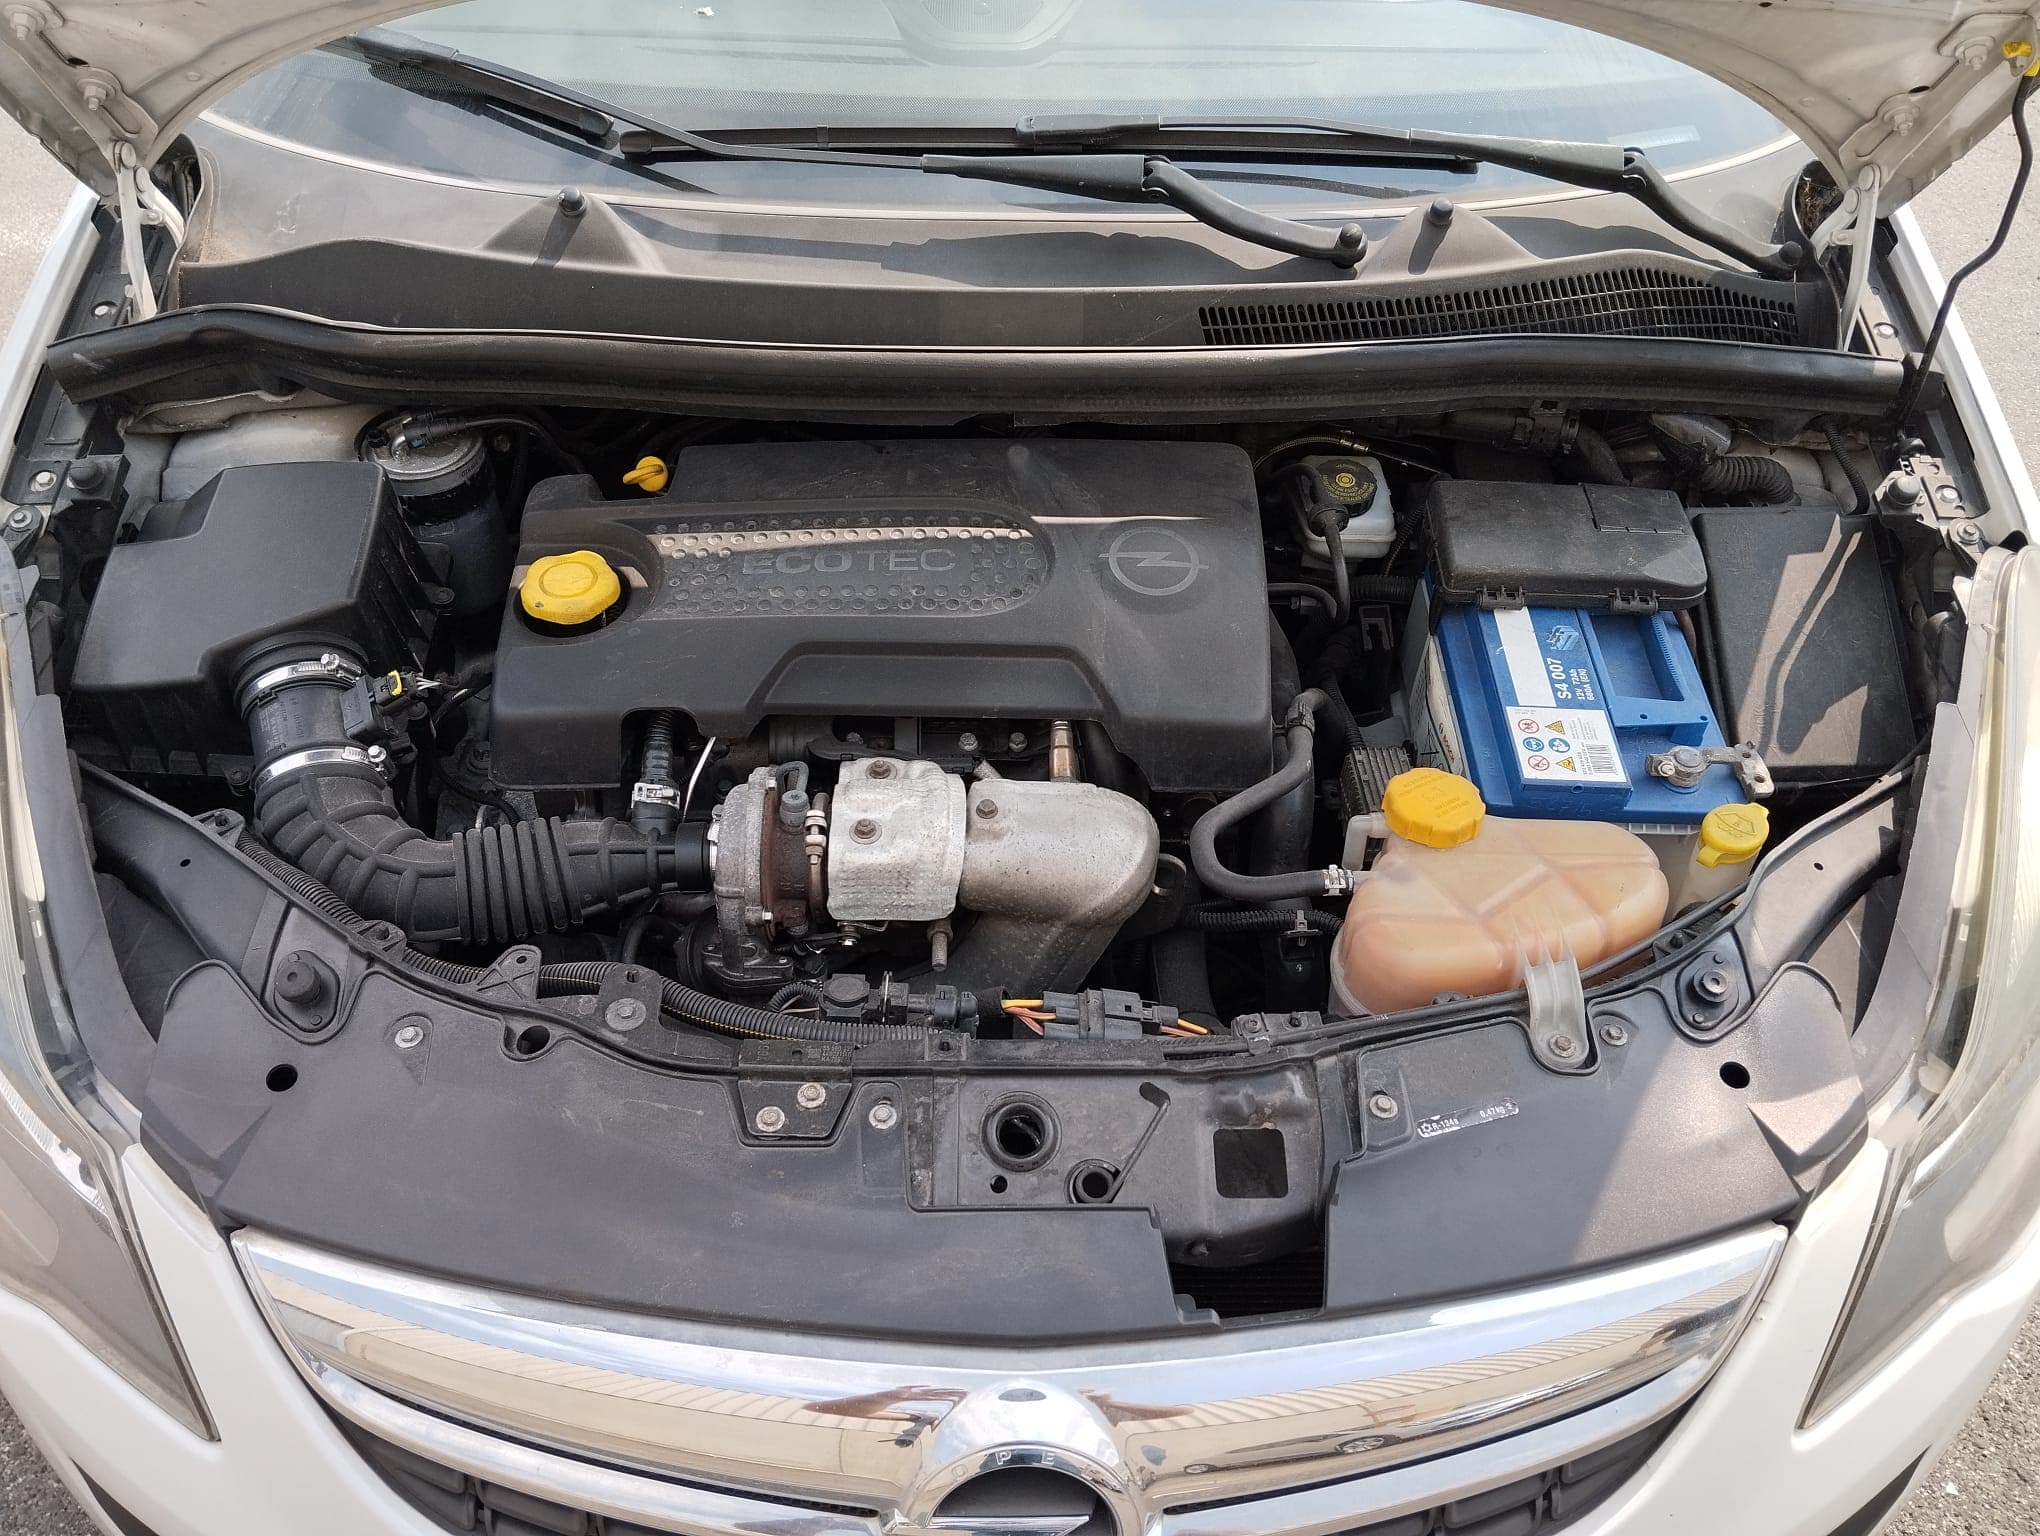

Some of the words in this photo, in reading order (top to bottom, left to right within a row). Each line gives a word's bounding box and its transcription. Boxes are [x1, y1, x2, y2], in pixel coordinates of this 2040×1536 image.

[742, 549, 956, 574] ECOTEC
[1547, 658, 1566, 680] 007
[1554, 683, 1572, 699] S4
